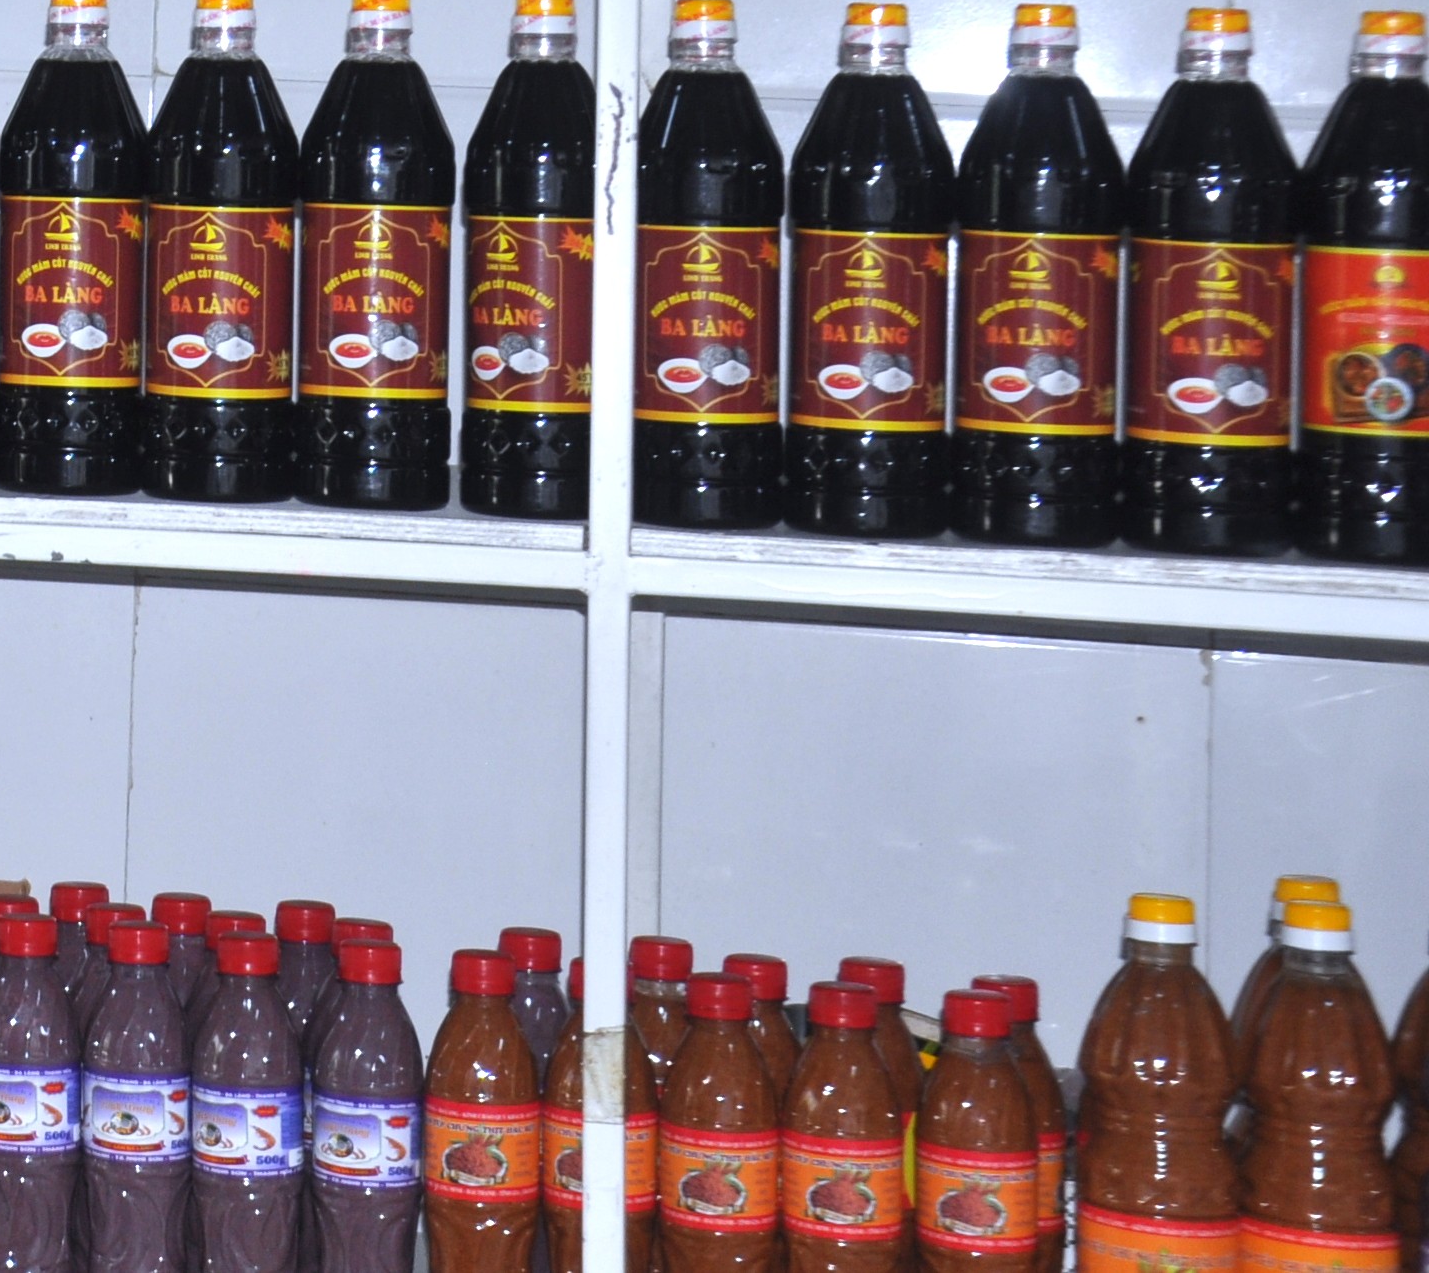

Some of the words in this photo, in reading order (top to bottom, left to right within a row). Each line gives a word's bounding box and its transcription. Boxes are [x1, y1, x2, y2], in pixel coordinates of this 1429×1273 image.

[197, 266, 212, 278] CỐT
[25, 285, 47, 302] BA
[52, 281, 103, 304] LÀNG
[170, 296, 193, 314] BA
[198, 292, 250, 316] LÀNG
[332, 294, 357, 312] BA
[363, 291, 414, 314] LÀNG
[473, 306, 489, 324] BA
[493, 303, 544, 326] LÀNG
[661, 318, 686, 336] BA
[691, 314, 745, 337] LÀNG
[822, 323, 848, 342] BA
[853, 321, 909, 344] LÀNG
[986, 326, 1013, 344] BA
[1018, 323, 1076, 346] LÀNG
[256, 1155, 286, 1166] 500g
